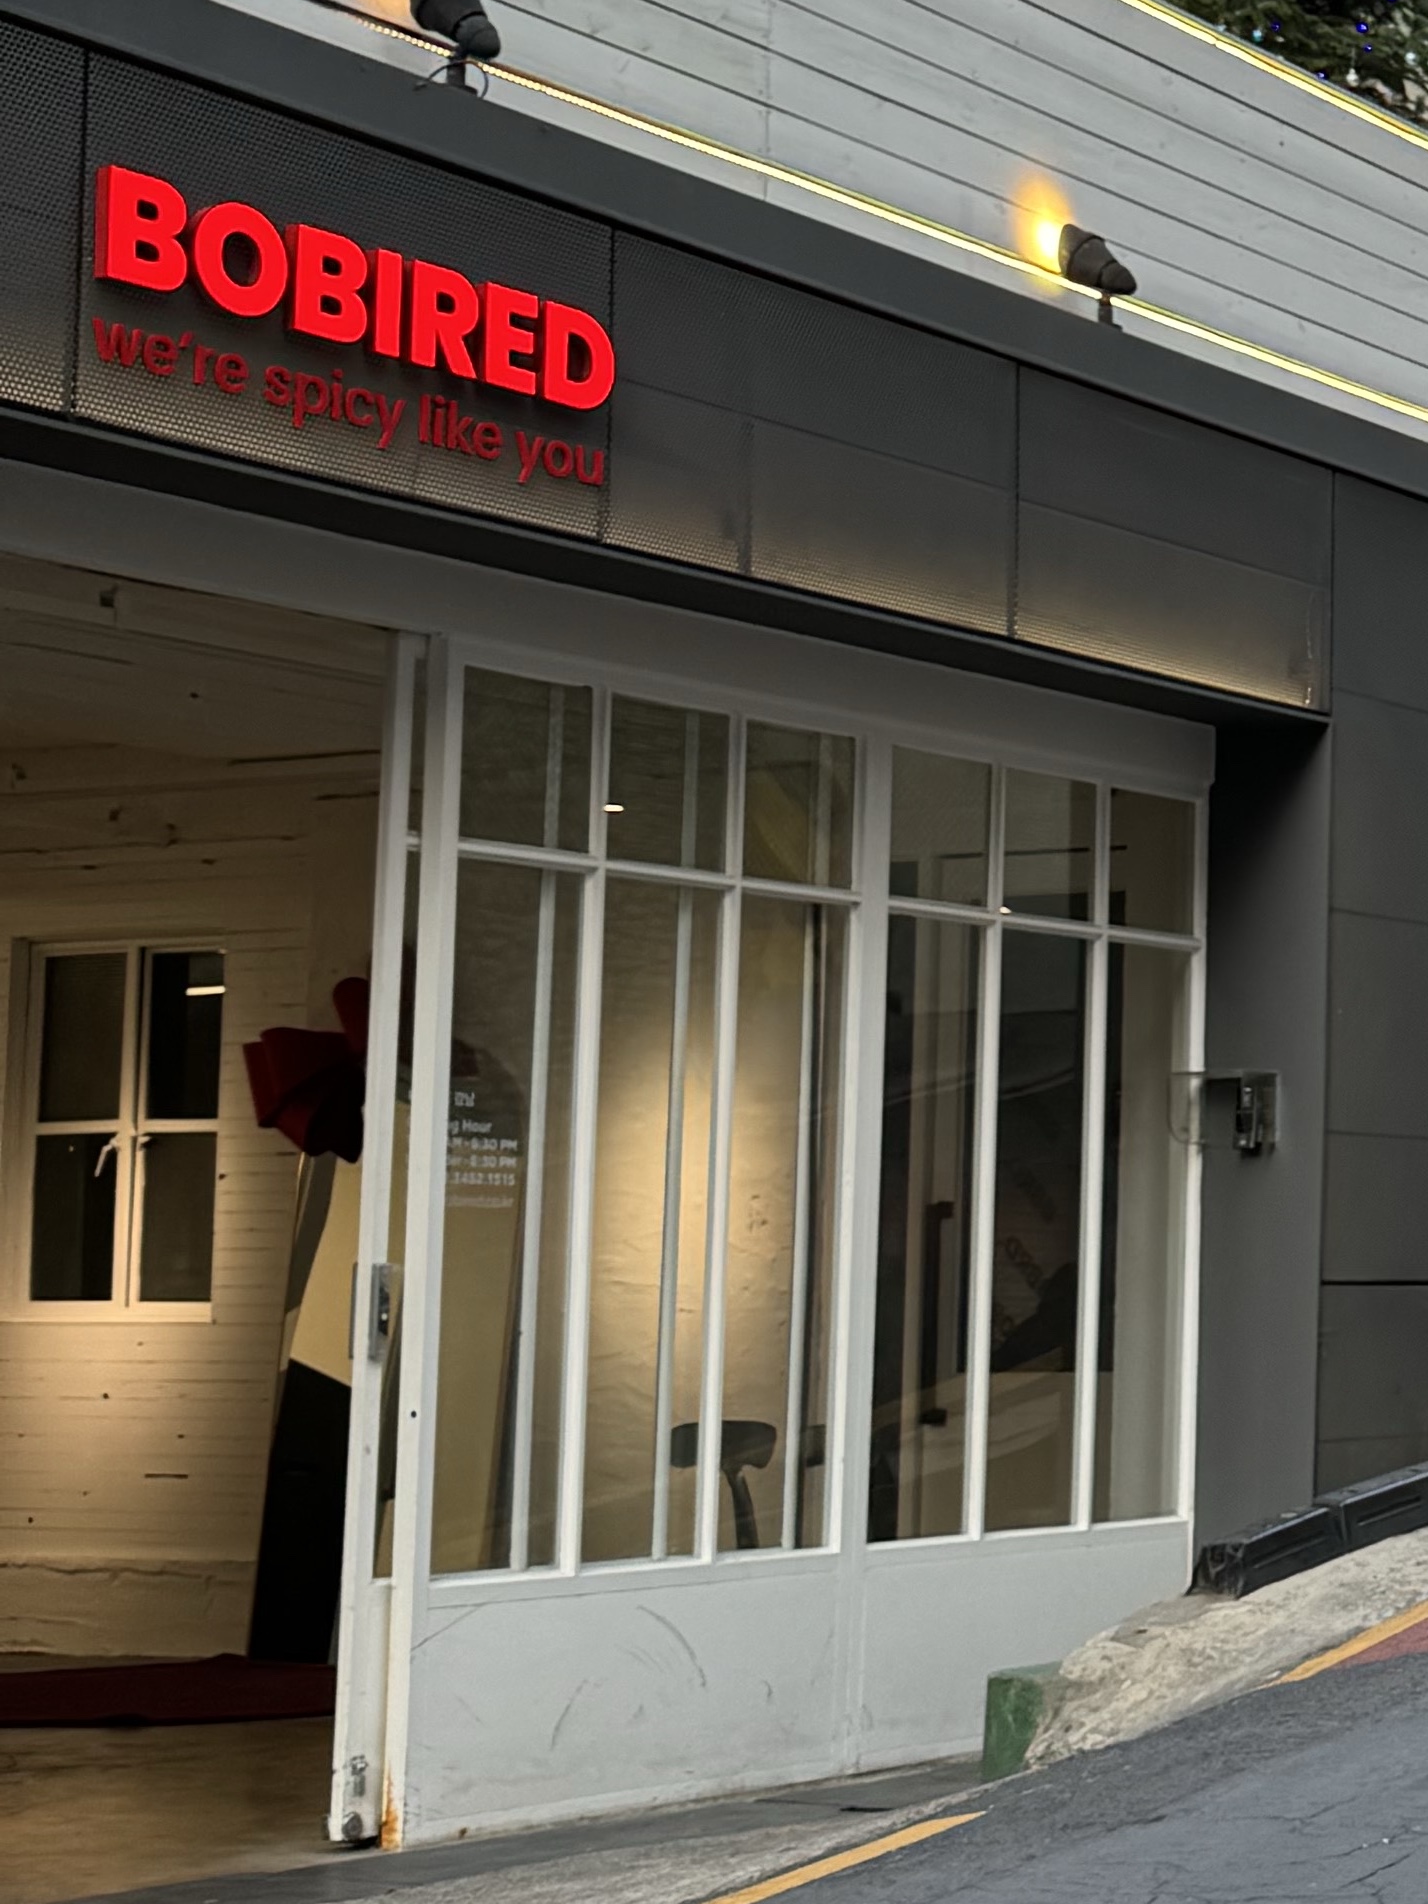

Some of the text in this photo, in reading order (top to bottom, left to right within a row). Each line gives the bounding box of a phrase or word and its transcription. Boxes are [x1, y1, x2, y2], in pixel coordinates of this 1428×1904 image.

[95, 164, 616, 411] BOBIRED
[92, 316, 605, 486] we're spicy like you
